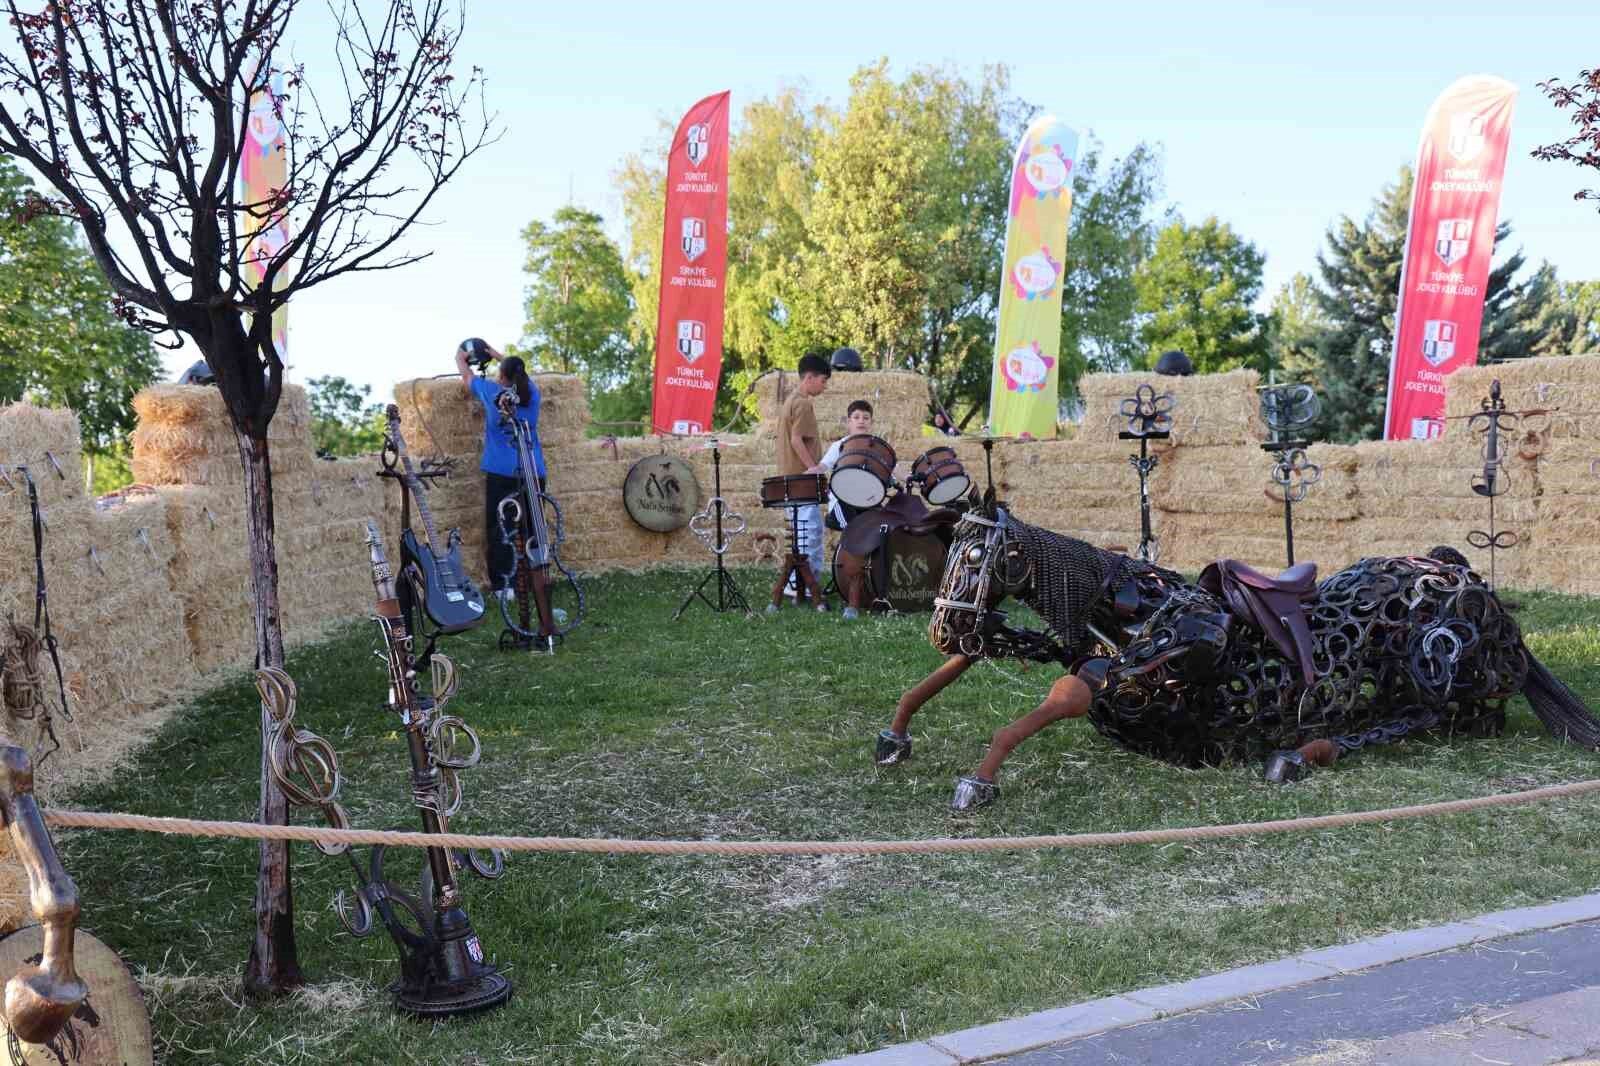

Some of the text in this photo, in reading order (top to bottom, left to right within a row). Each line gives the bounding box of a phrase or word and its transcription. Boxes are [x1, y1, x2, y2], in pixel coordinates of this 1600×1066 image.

[679, 265, 707, 277] TÜRKİYE
[1431, 270, 1465, 283] TÜRKİYE
[1416, 282, 1478, 297] JOKEY KULÜBÜ
[676, 366, 704, 378] TÜRKİYE
[1416, 368, 1442, 382] TÜRKİ
[665, 376, 714, 391] JOKEY KULÜBÜ
[1404, 380, 1427, 393] JOKEY
